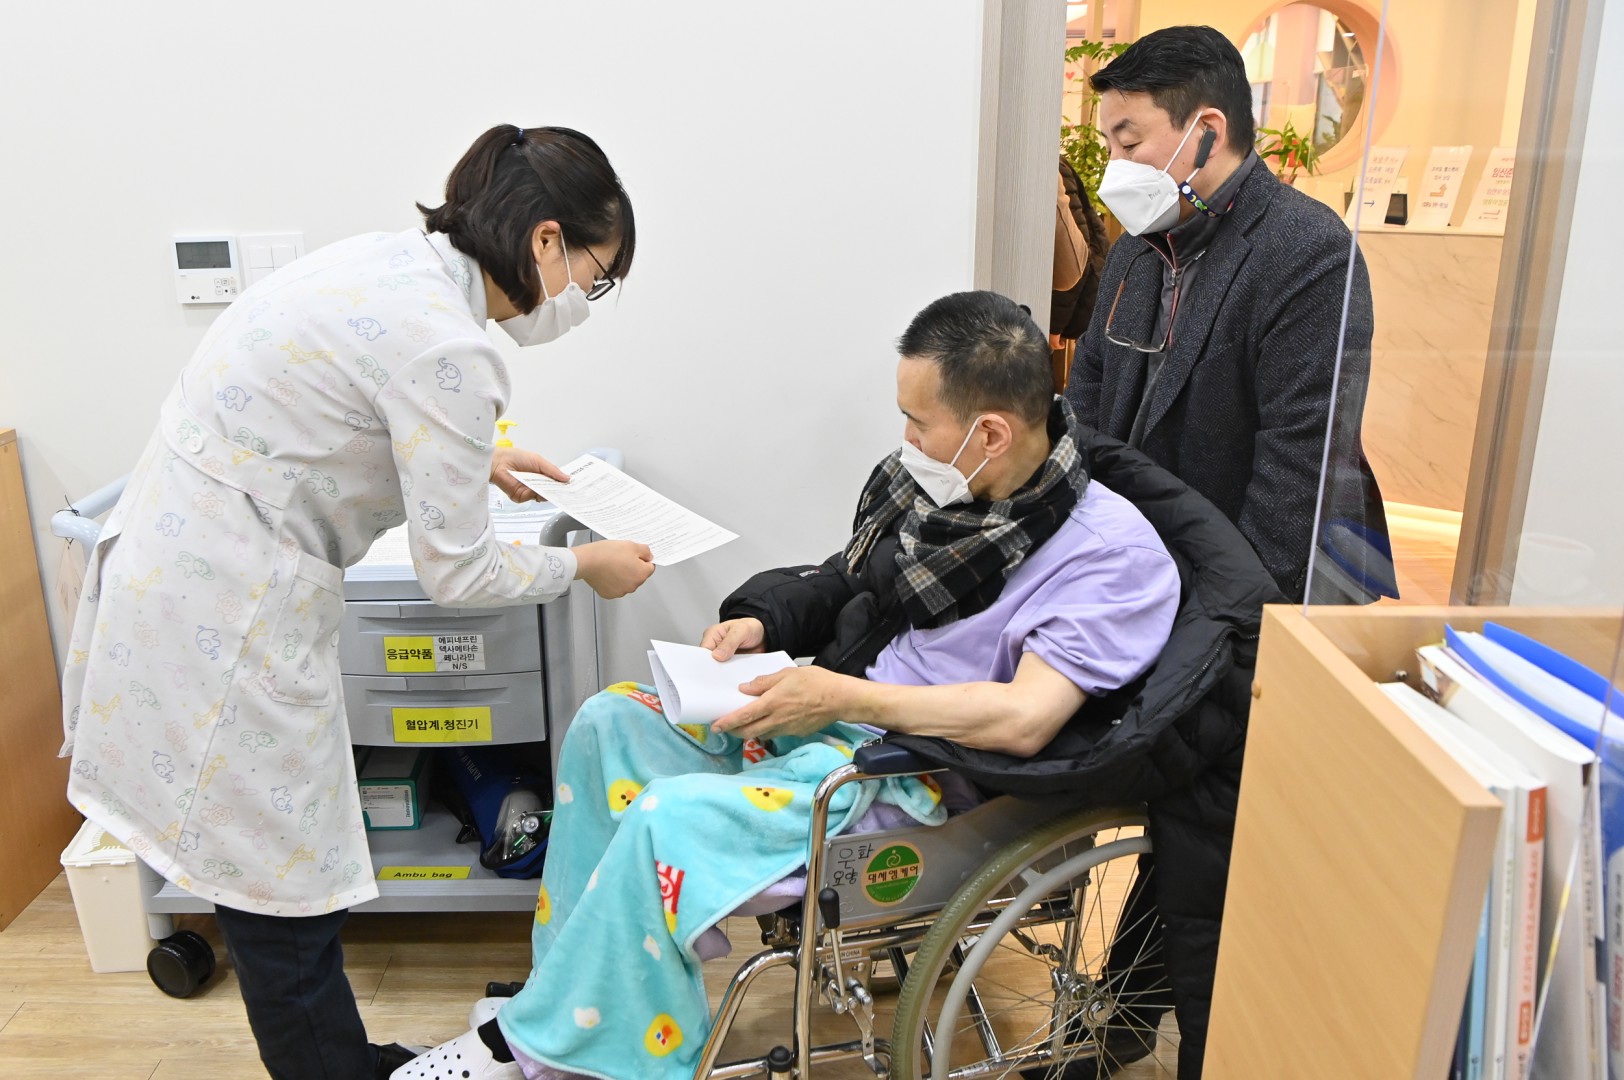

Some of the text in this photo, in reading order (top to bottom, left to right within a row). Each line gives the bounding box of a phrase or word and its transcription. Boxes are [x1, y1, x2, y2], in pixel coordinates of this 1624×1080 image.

[438, 635, 478, 645] 에피네프린
[439, 644, 479, 653] 덱사메타손
[387, 648, 433, 660] 응급약품
[405, 719, 479, 731] 혈압계,청진기
[431, 871, 453, 879] bag
